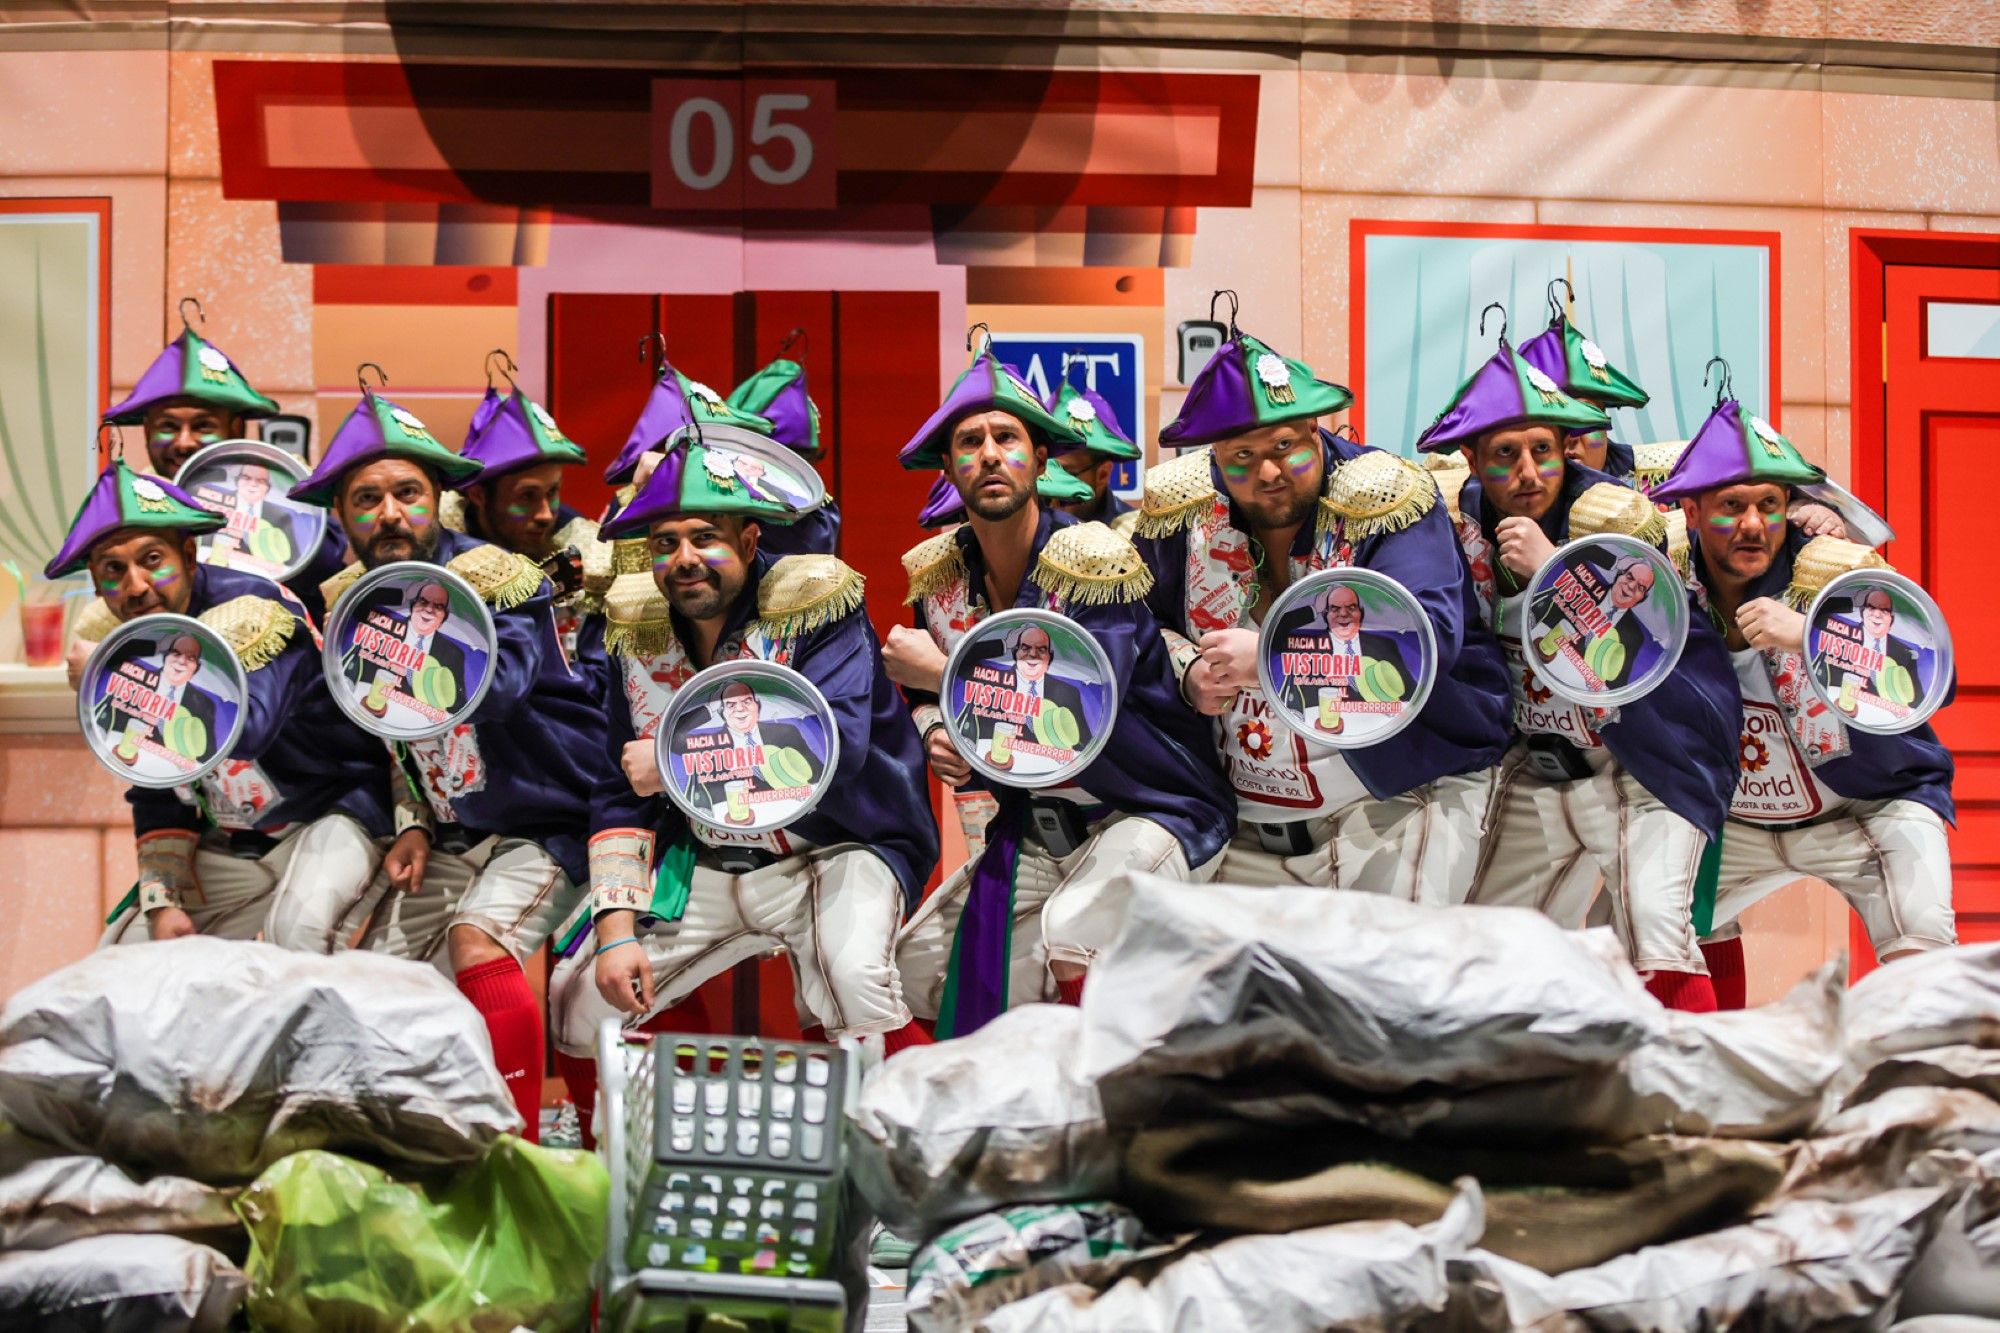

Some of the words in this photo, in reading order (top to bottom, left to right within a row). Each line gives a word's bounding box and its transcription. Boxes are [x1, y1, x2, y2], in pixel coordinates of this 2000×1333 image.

[670, 94, 814, 191] 05
[1575, 563, 1595, 590] HACIA
[1594, 585, 1606, 601] LA
[1553, 569, 1613, 639] VISTORIA
[368, 610, 393, 631] HACIA
[394, 623, 406, 637] LA
[1826, 618, 1850, 636] HACIA
[1852, 626, 1862, 641] LA
[353, 622, 426, 672] VISTORIA
[1288, 637, 1315, 649] HACIA
[1318, 638, 1331, 649] LA
[1569, 632, 1582, 645] AL
[1818, 630, 1885, 672] VISTORIA
[1281, 652, 1361, 676] VISTORIA
[146, 673, 159, 688] LA
[973, 666, 1000, 683] HACIA
[1003, 673, 1015, 686] LA
[106, 673, 177, 720] VISTORIA
[964, 681, 1041, 717] VISTORIA
[1338, 687, 1349, 698] AL
[686, 735, 714, 750] HACIA
[719, 733, 730, 745] LA
[1014, 724, 1024, 737] AL
[682, 745, 765, 776] VISTORIA
[744, 779, 756, 789] AL
[1237, 777, 1264, 792] COSTA
[1266, 786, 1283, 795] DEL
[1285, 788, 1303, 797] SOL
[1763, 803, 1779, 811] DEL
